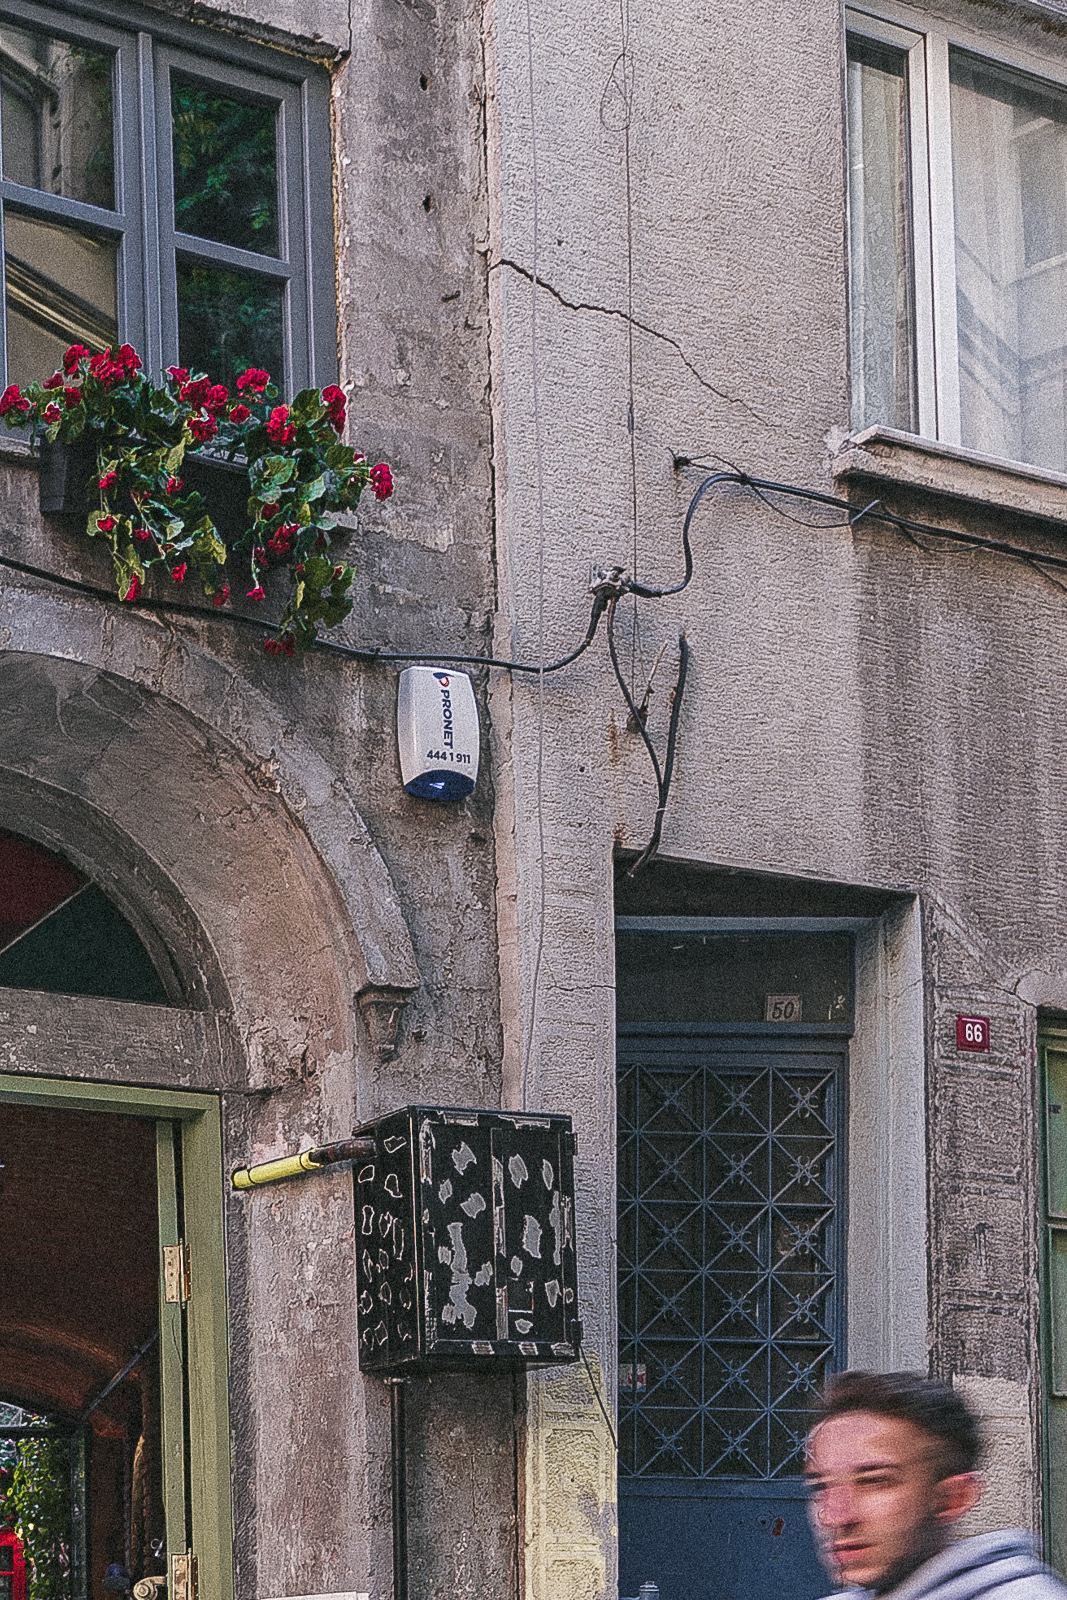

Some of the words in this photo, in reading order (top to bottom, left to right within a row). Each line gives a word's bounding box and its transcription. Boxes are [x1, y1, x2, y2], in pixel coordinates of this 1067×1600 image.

[441, 689, 453, 749] PRONET
[426, 750, 447, 760] 444
[456, 753, 470, 764] 911
[771, 1001, 795, 1019] 50
[965, 1023, 983, 1042] 66
